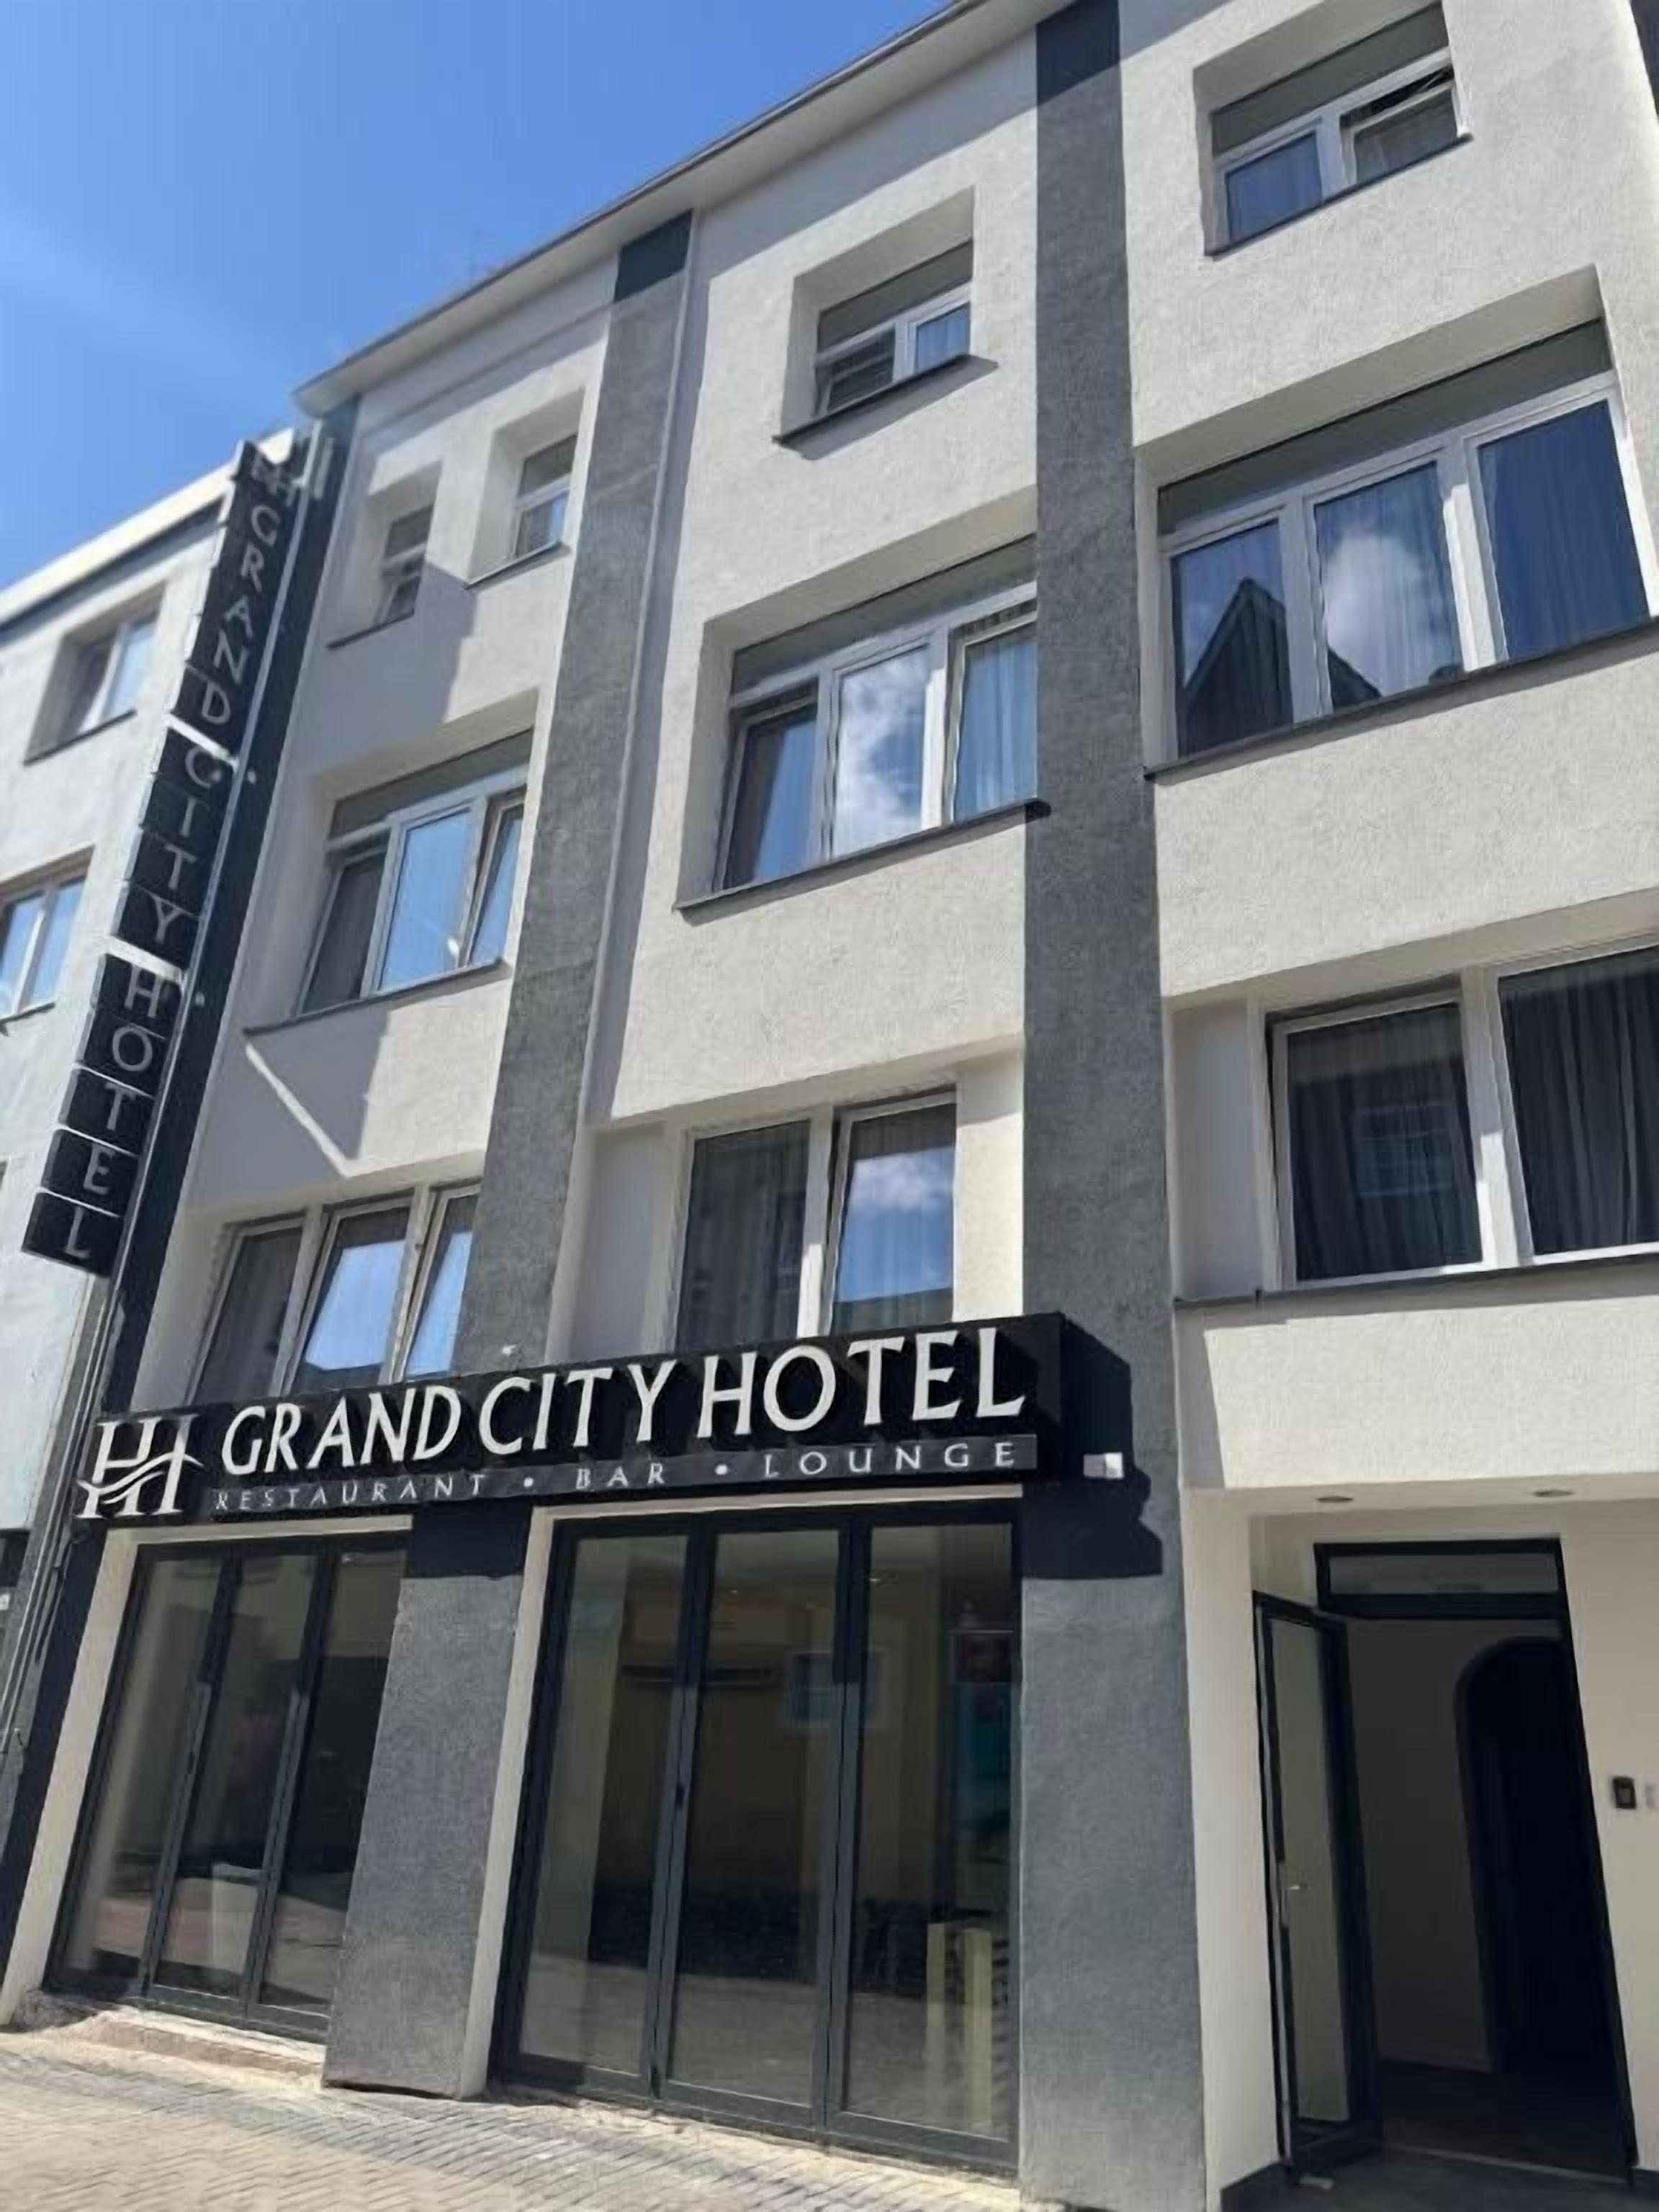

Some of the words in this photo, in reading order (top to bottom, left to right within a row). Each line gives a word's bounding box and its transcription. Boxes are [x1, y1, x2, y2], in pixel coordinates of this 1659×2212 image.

[199, 504, 281, 724] GRAND
[153, 745, 223, 945] CITY
[63, 966, 167, 1259] HOTEL
[215, 1473, 486, 1511] RESTAURANT
[575, 1462, 666, 1491] BAR
[763, 1442, 1017, 1477] LOUNGE
[221, 1385, 461, 1475] GRAND
[478, 1359, 678, 1455] CITY
[696, 1327, 1026, 1439] HOTEL
